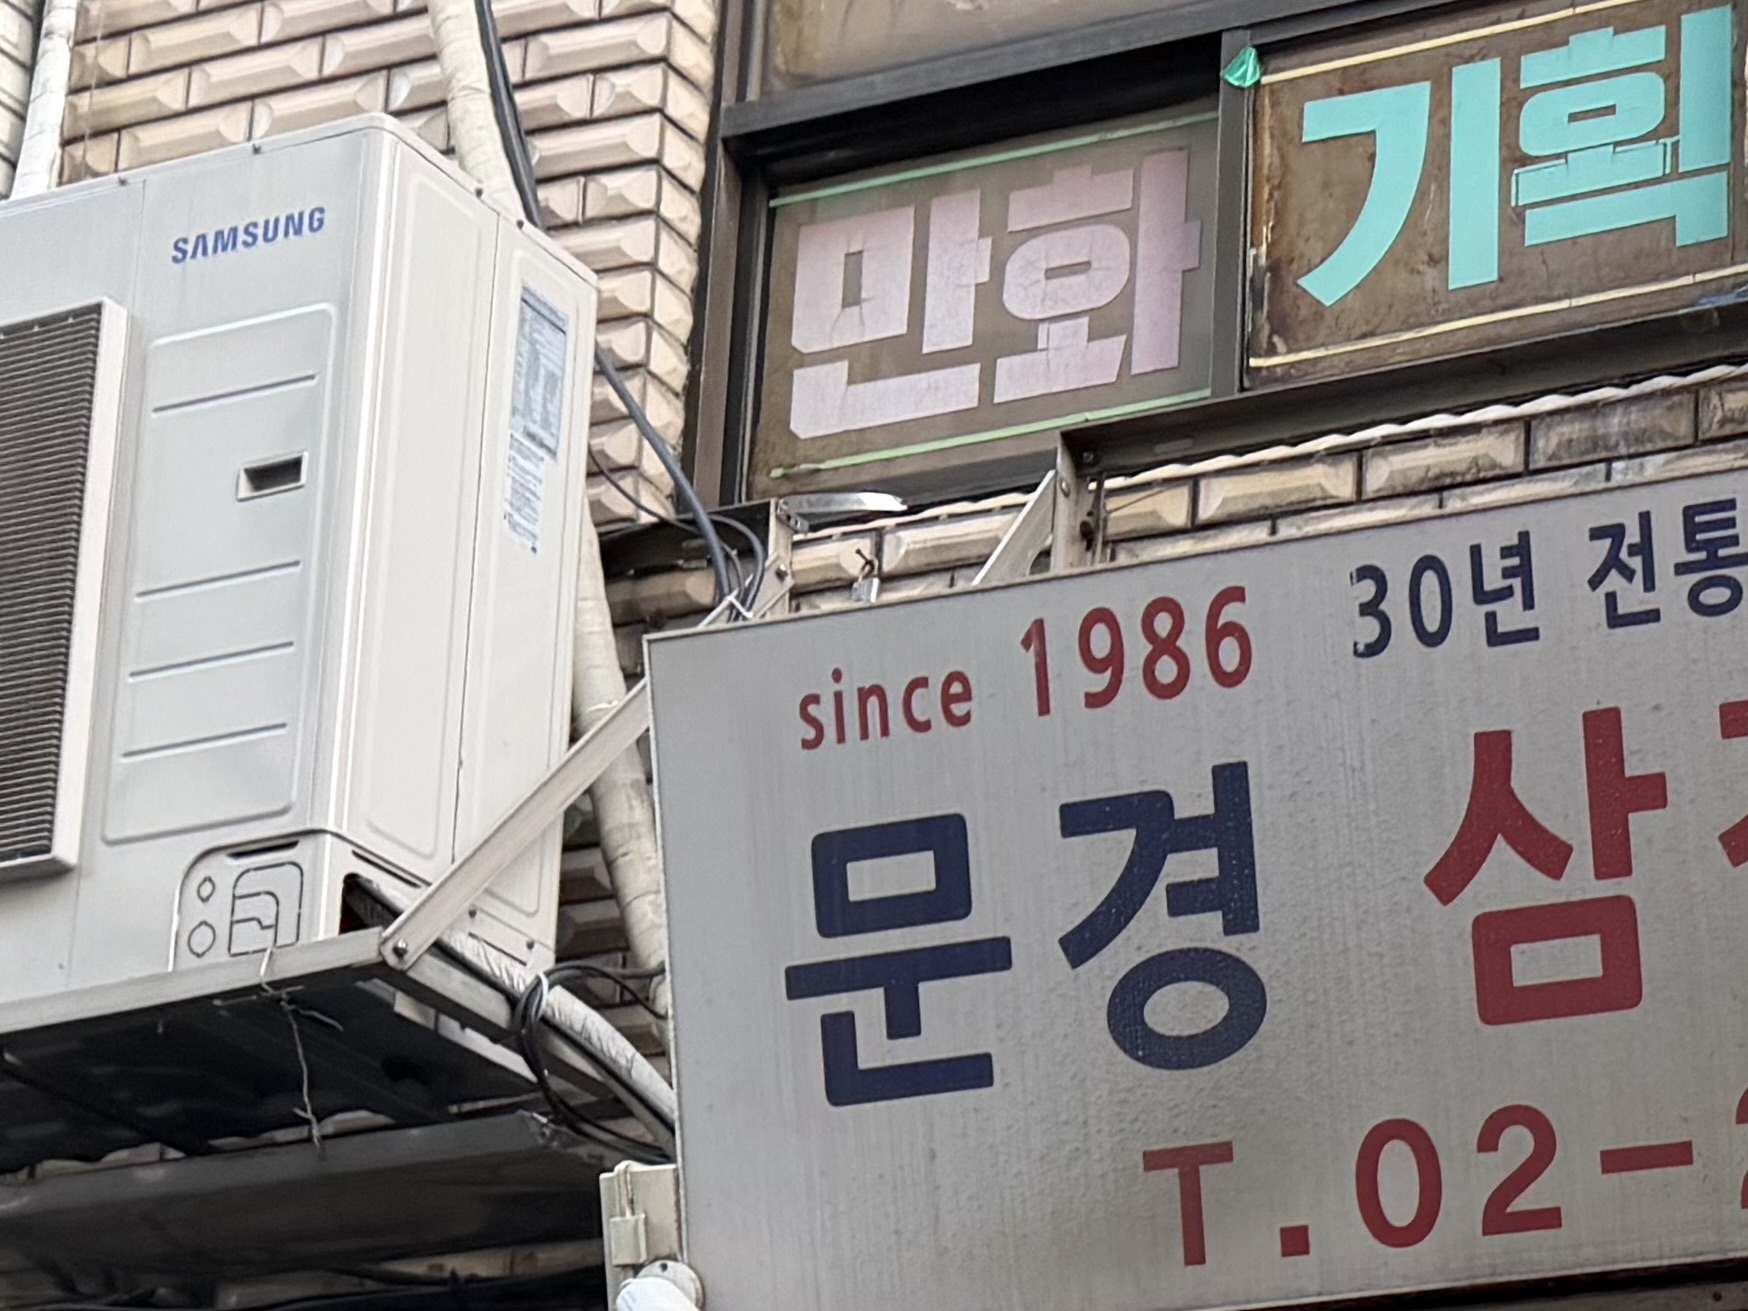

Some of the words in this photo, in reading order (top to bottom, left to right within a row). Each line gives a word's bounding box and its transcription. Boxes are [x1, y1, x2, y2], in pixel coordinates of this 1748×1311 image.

[170, 206, 326, 265] SAMSUNG
[790, 148, 1199, 439] 만화
[1297, 5, 1732, 307] 기획
[797, 667, 974, 749] since
[1019, 585, 1254, 716] 1986
[1349, 529, 1540, 658] 30년
[784, 760, 1268, 1107] 문경
